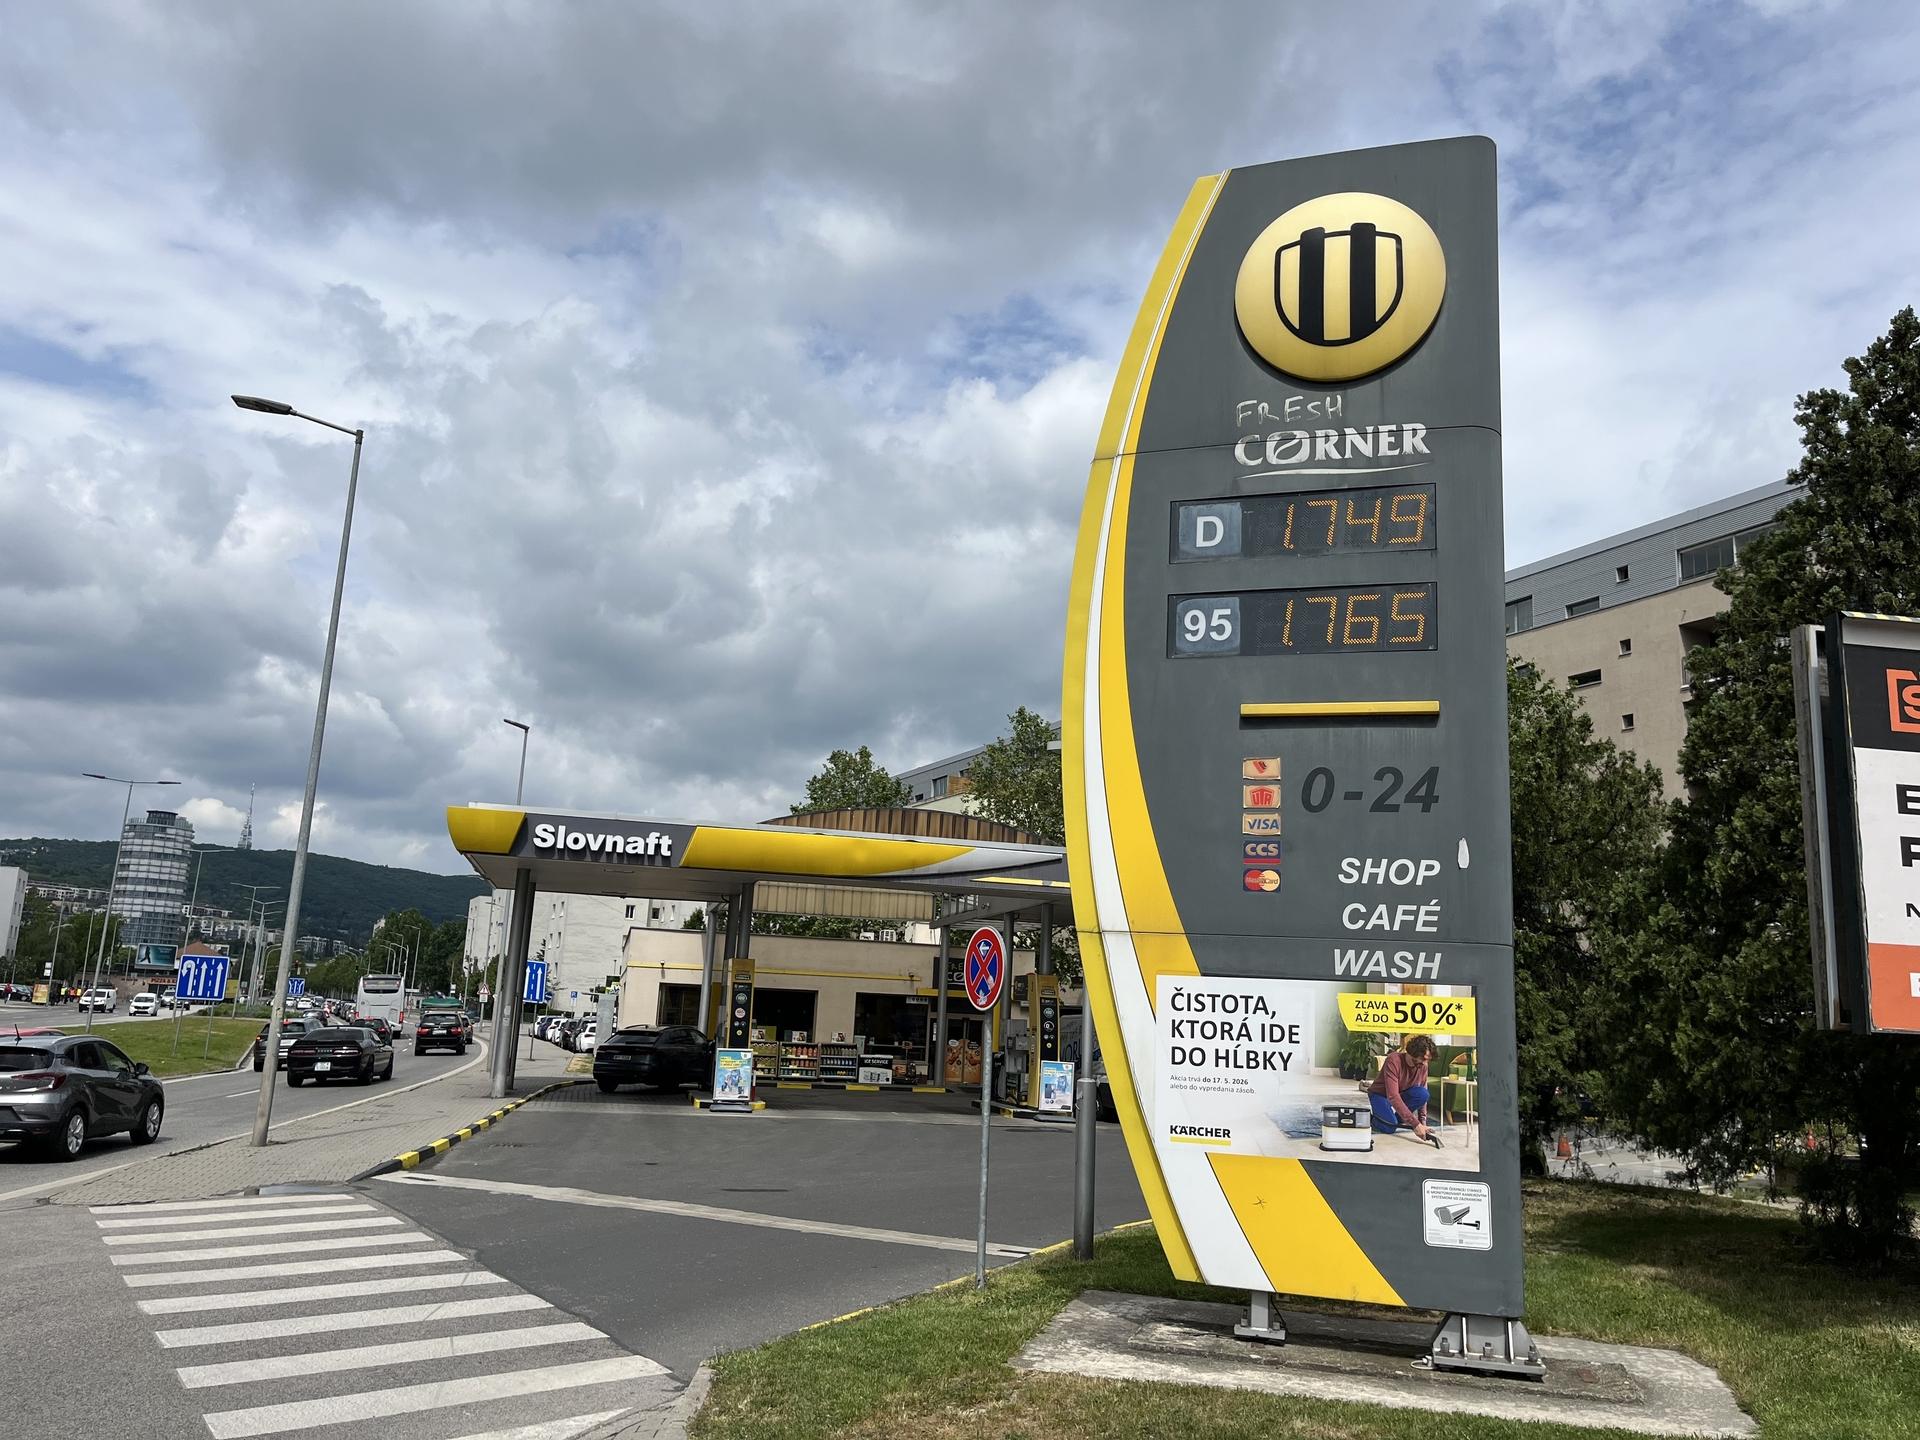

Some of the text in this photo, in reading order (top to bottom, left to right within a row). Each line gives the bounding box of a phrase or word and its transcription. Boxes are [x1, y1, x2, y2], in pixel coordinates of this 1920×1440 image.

[1235, 394, 1344, 428] FRESH
[1233, 422, 1432, 466] CORNER
[1195, 515, 1225, 549] D
[1183, 608, 1233, 643] 95
[1301, 766, 1440, 814] 0-24
[532, 823, 672, 857] Slovnaft
[1247, 818, 1280, 830] VISA
[1245, 843, 1279, 857] CCS
[1337, 857, 1441, 886] SHOP
[1341, 899, 1441, 933] CAFÉ
[1333, 948, 1442, 980] WASH
[1170, 987, 1277, 1020] ČISTOTA,
[1354, 999, 1389, 1010] ZĽAVA
[1393, 1001, 1427, 1025] 50
[1355, 1011, 1389, 1023] AŽ DO
[1171, 1017, 1301, 1044] KTORÁ IDE
[1171, 1044, 1293, 1072] DO HĹBKY
[1169, 1124, 1231, 1139] KÄRCHER
